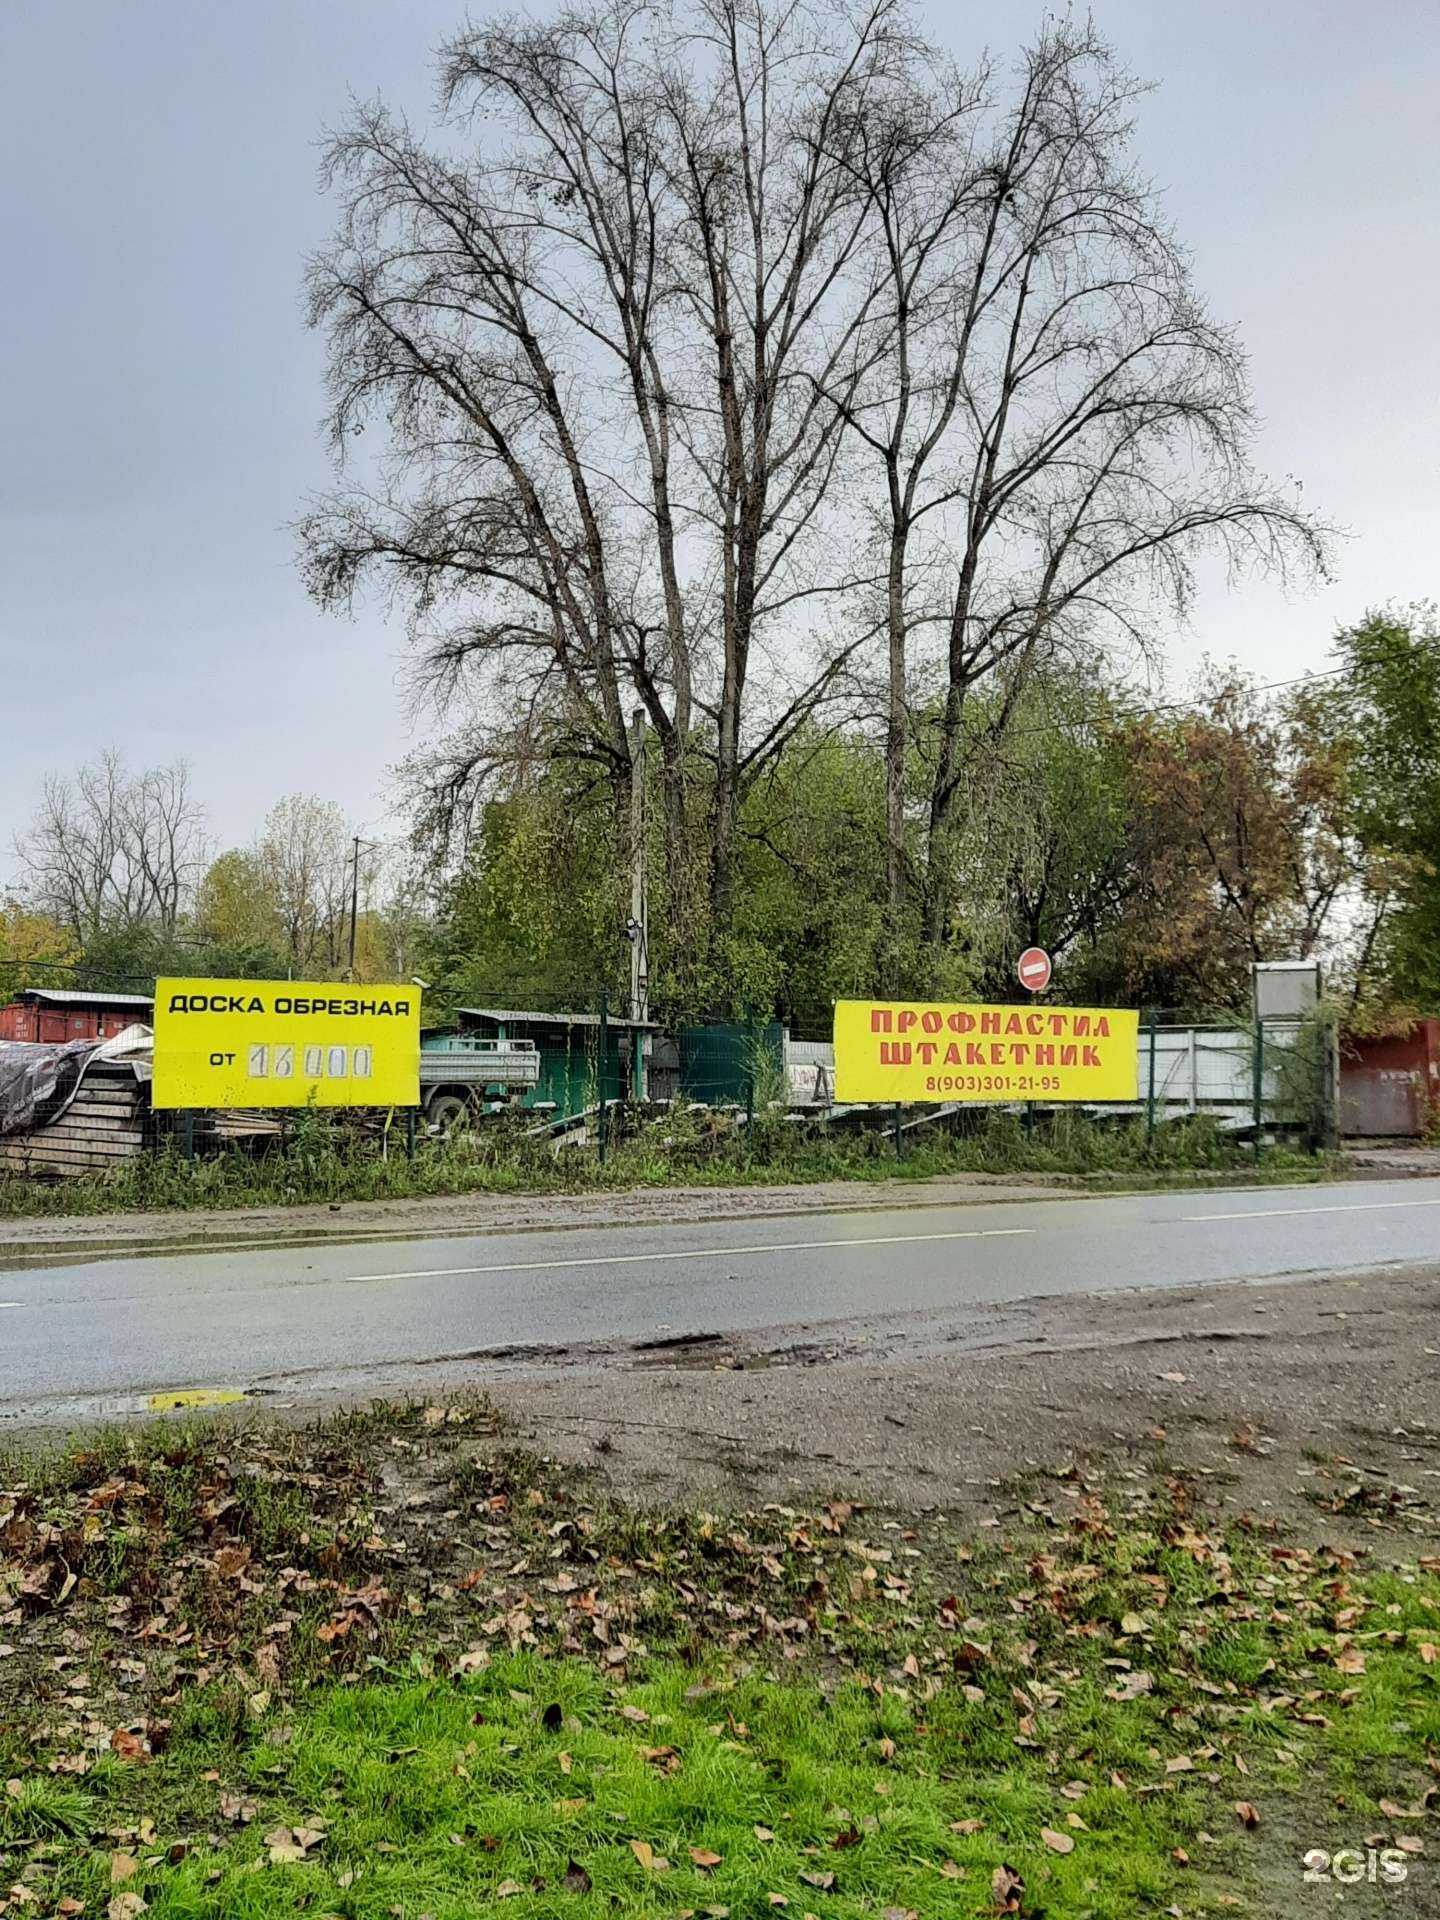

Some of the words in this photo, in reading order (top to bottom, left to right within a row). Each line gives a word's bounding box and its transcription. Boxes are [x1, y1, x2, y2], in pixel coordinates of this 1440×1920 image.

[169, 995, 265, 1014] ДОСКА
[274, 998, 410, 1017] ОБРЕЗНАЯ
[870, 1009, 1111, 1037] ПРОФНАСТИЛ
[880, 1042, 1102, 1067] ШТАКЕТНИК
[926, 1077, 1060, 1092] 8(903)301-21-95
